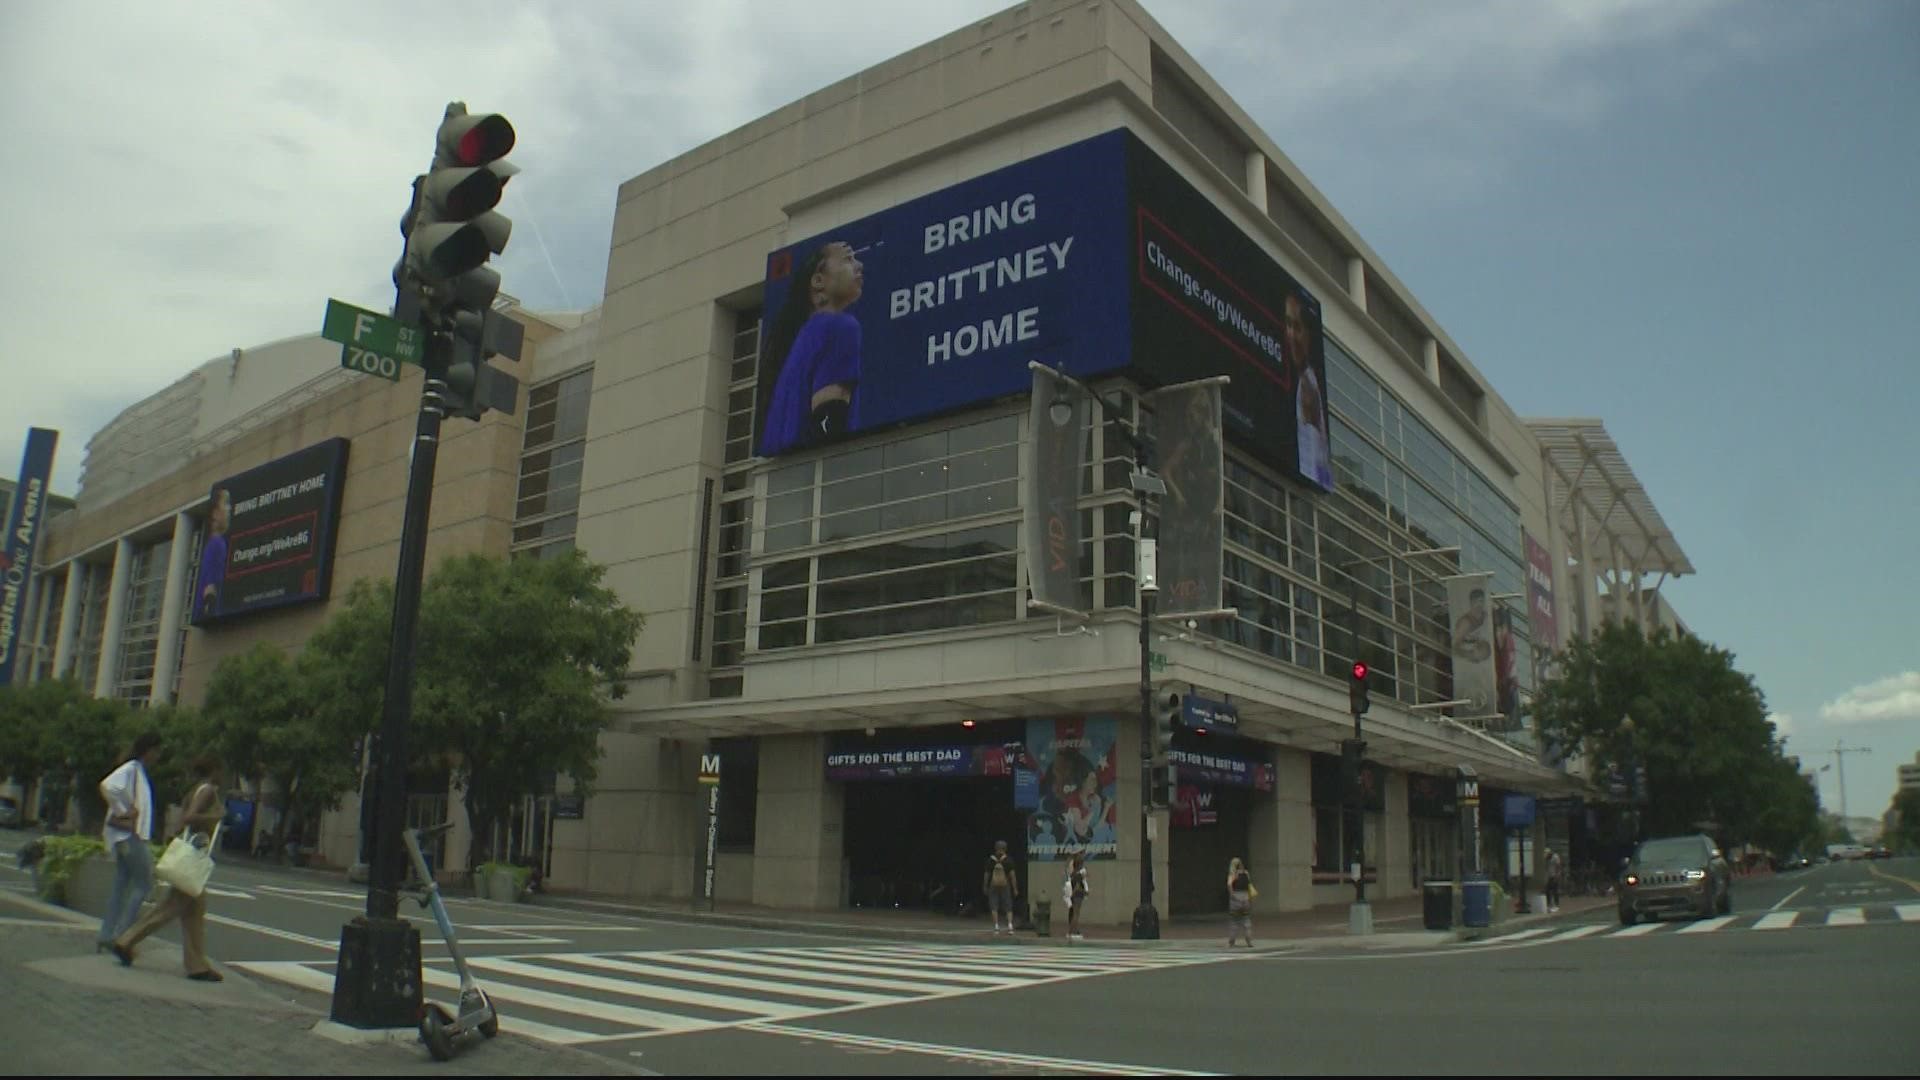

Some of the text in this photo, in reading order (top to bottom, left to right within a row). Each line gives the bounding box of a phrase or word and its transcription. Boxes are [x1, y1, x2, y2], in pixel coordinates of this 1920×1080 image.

[924, 193, 1036, 254] BRING
[890, 236, 1074, 319] BRITTNEY
[1147, 241, 1283, 362] Change.org/WeAreBG
[354, 312, 416, 342] F ST
[927, 306, 1039, 366] HOME
[349, 346, 396, 377] 700
[395, 341, 415, 357] NW
[234, 473, 326, 517] BRING BRITTNEY HOME
[16, 477, 42, 545] Arena
[701, 755, 720, 774] M
[828, 749, 961, 766] GIFTS FOR THE BEST DAD
[1187, 753, 1202, 765] FOR
[1202, 755, 1216, 767] THE
[1216, 756, 1232, 770] BEST
[1232, 759, 1246, 772] DAD
[1464, 782, 1478, 796] M
